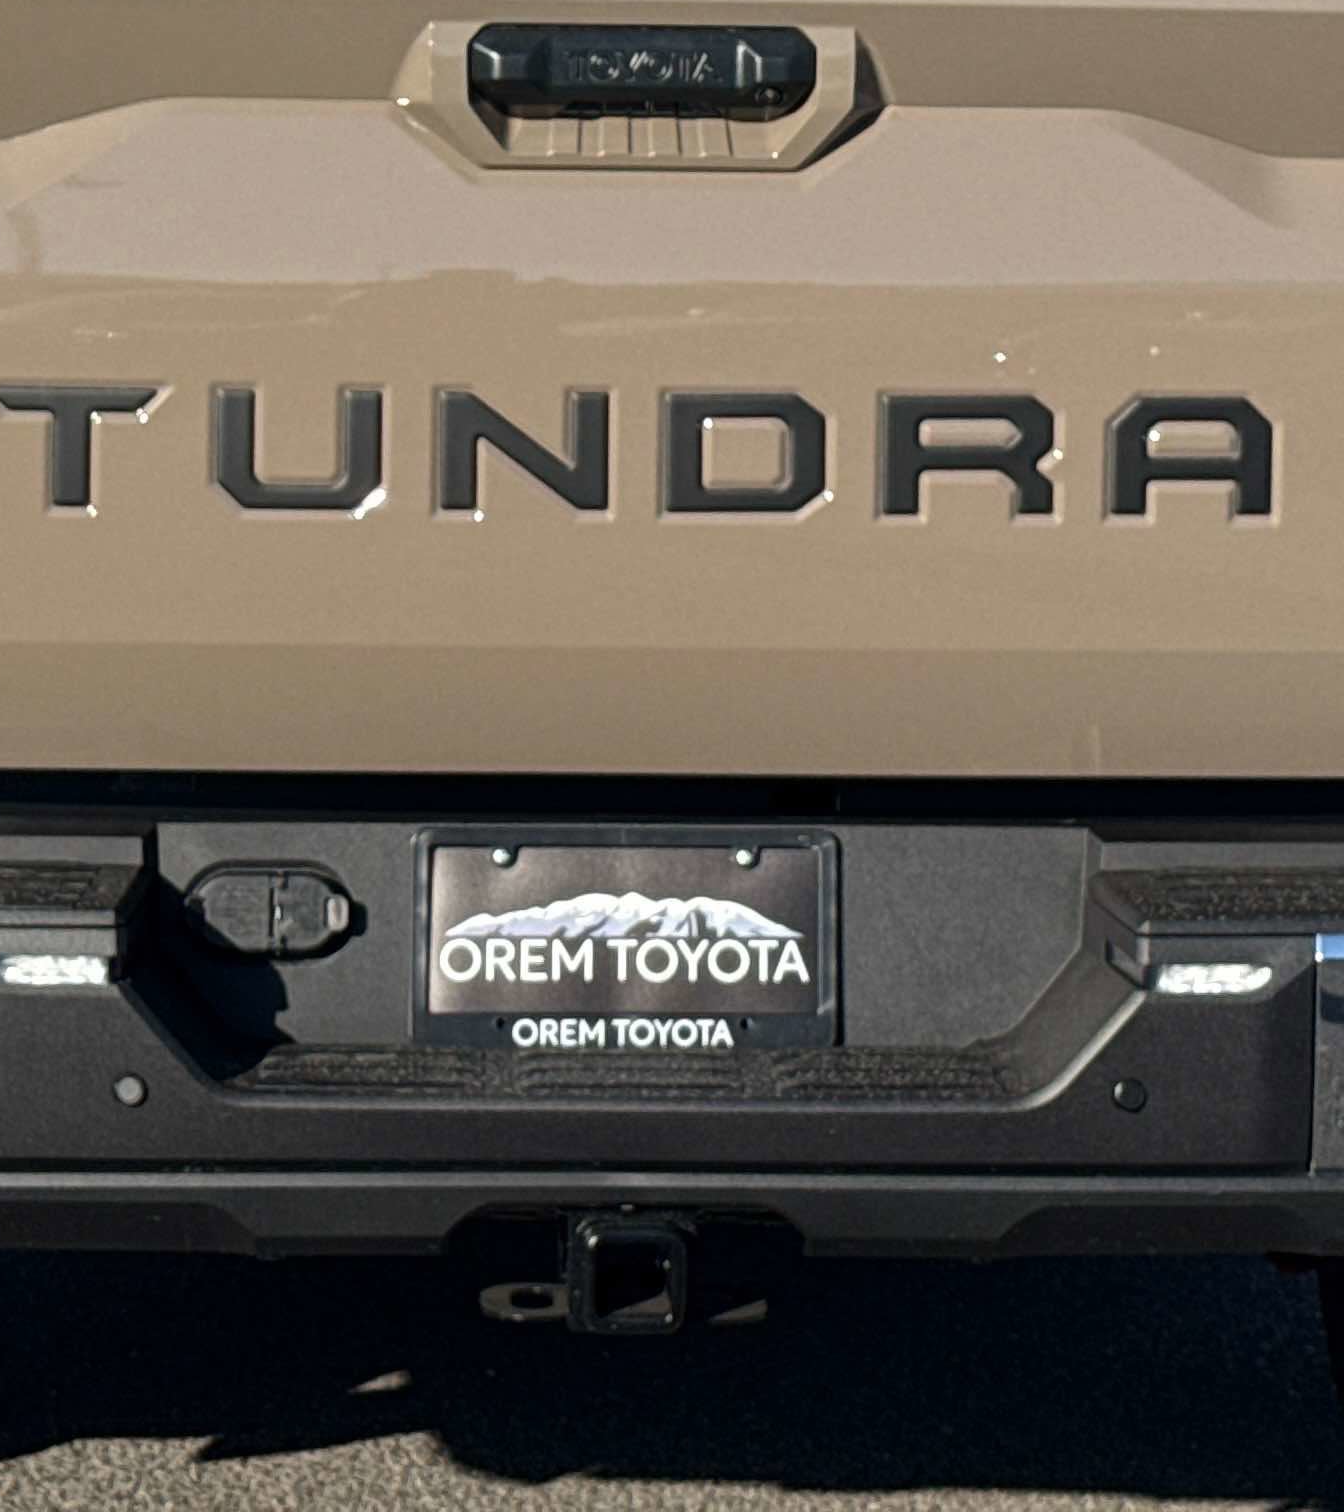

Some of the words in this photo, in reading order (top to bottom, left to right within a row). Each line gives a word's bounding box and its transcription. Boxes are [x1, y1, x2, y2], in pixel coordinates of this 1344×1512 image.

[438, 938, 594, 983] OREM
[606, 938, 810, 984] TOYOTA
[511, 1017, 605, 1048] OREM
[611, 1017, 735, 1048] TOYOTA
